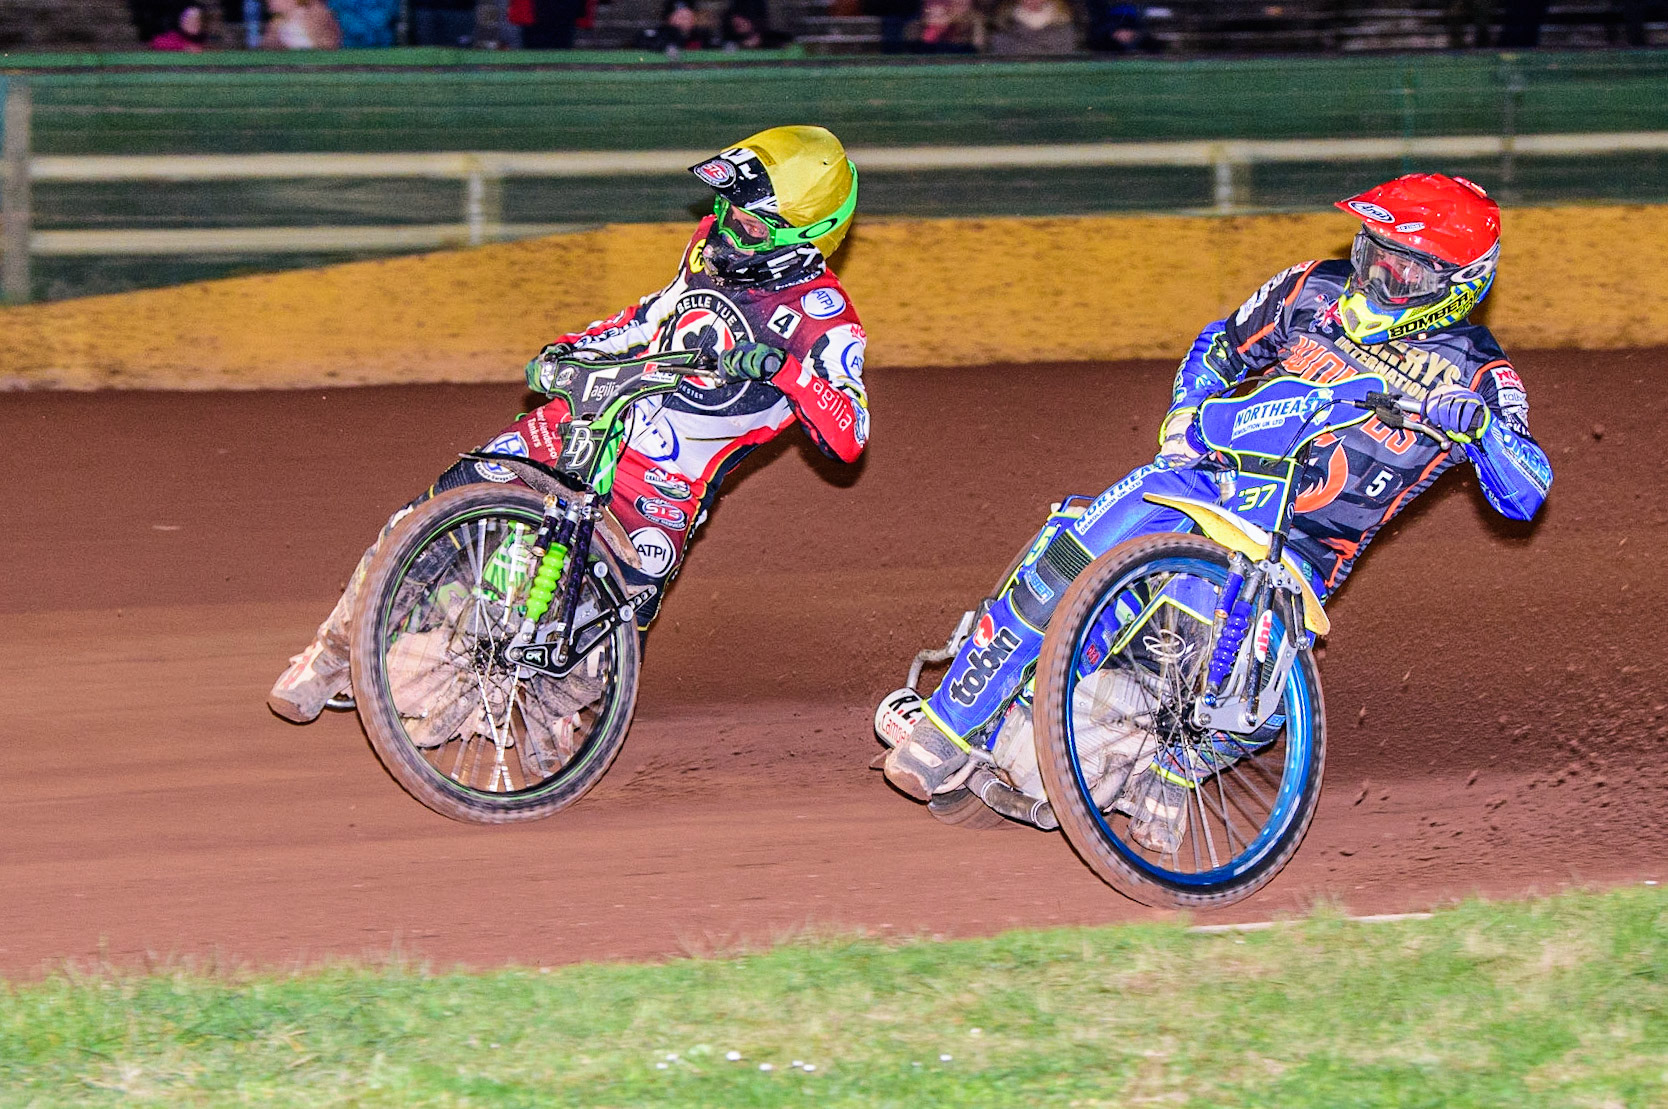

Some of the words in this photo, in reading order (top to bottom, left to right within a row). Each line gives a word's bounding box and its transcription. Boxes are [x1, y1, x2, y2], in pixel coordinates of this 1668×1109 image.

[676, 296, 712, 314] BELLE
[714, 303, 738, 328] VUE
[813, 290, 835, 310] ATPI
[1389, 293, 1469, 339] BOMBER
[773, 313, 795, 335] 4
[1334, 336, 1430, 400] INTERNATION
[812, 379, 853, 431] agilia
[527, 417, 542, 448] Tankers
[540, 421, 559, 460] Henderso
[1077, 466, 1151, 528] NORTHEA
[1365, 470, 1394, 498] 5
[637, 543, 668, 561] ATPI
[950, 627, 1023, 707] tobin
